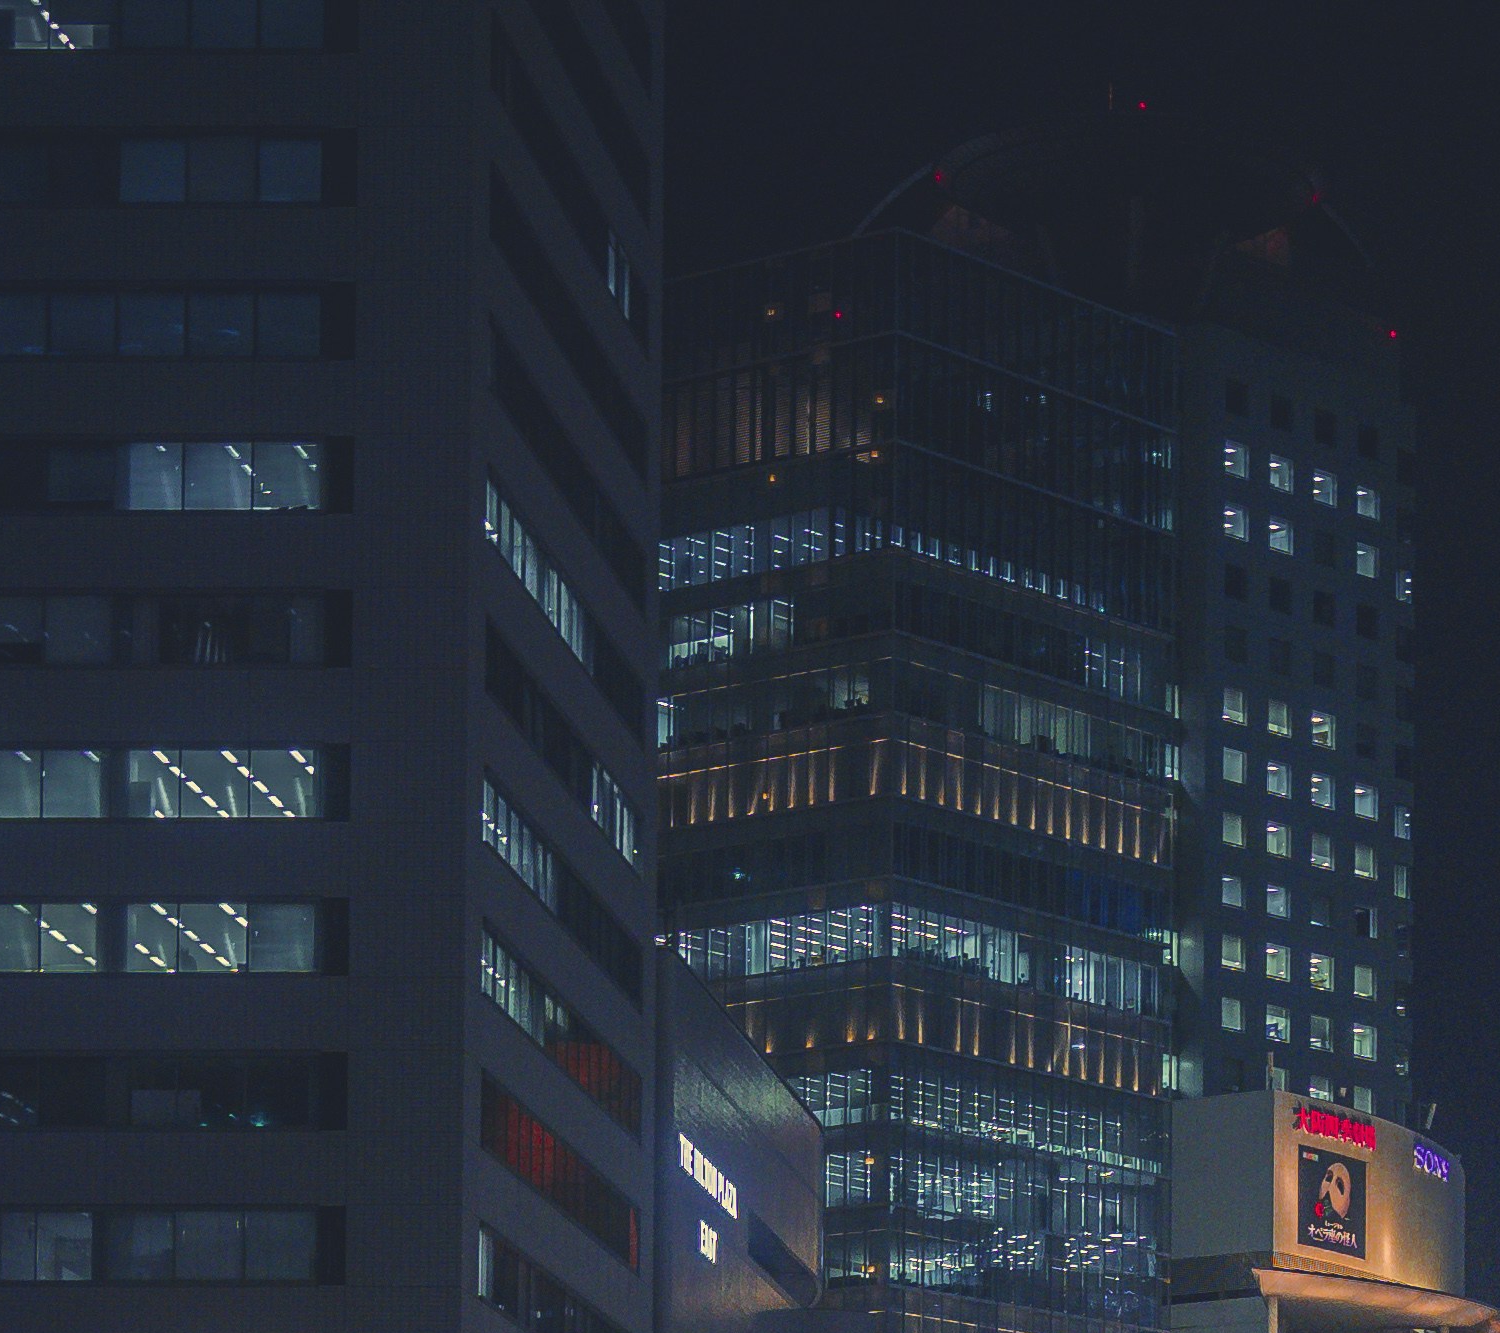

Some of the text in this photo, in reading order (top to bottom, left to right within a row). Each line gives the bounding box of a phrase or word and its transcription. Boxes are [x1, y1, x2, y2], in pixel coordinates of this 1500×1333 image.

[1413, 1143, 1450, 1183] SONY
[1308, 1224, 1358, 1249] オペラ座の怪人
